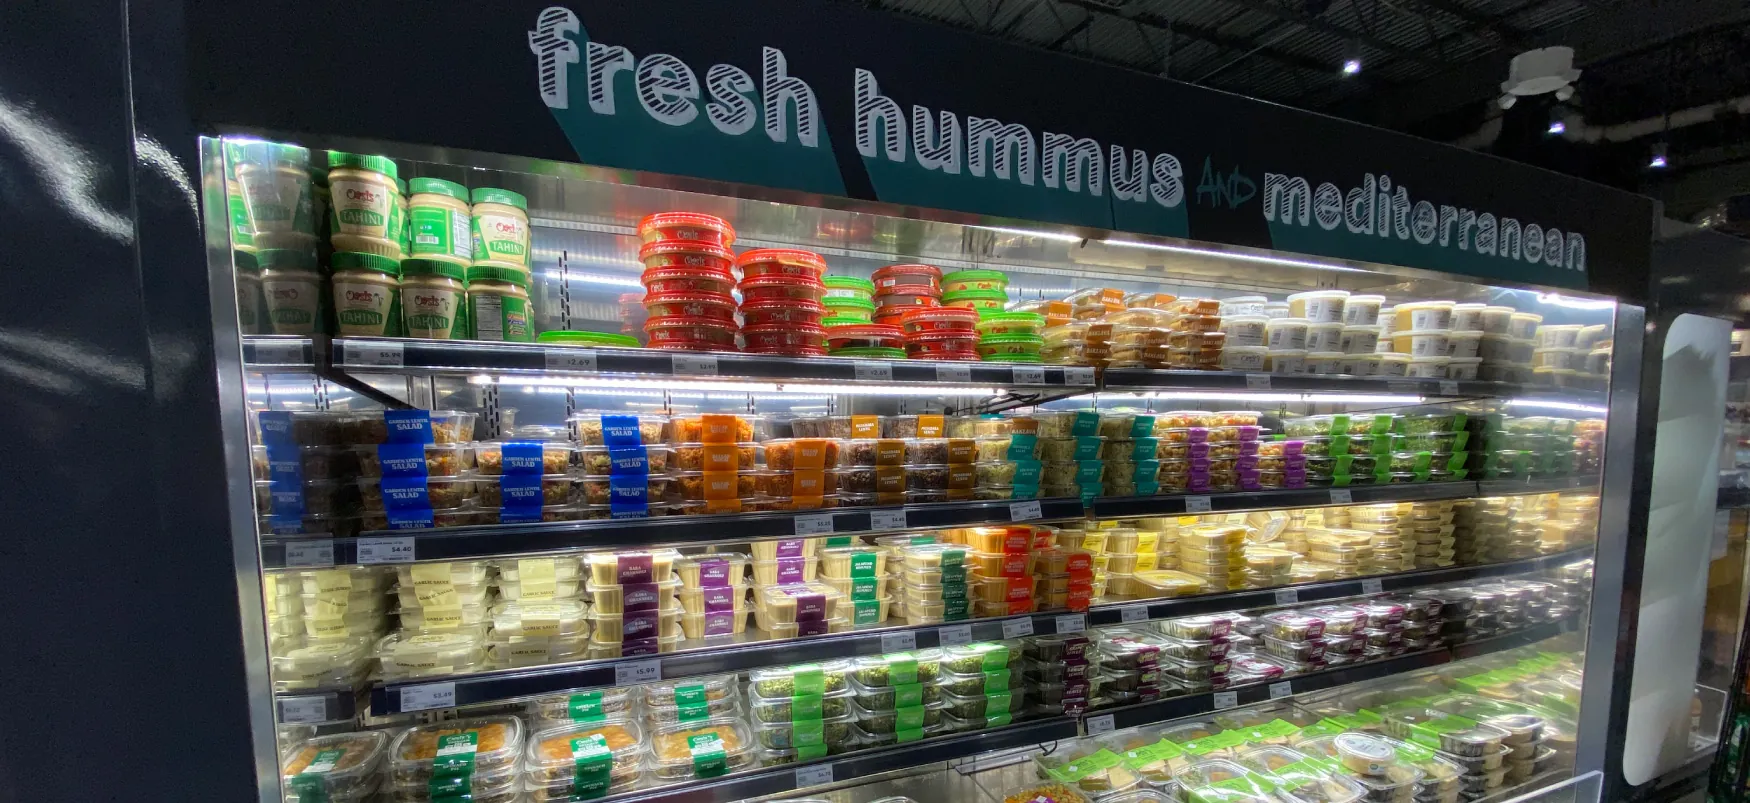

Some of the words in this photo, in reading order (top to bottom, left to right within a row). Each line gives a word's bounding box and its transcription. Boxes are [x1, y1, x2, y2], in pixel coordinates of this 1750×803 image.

[528, 7, 818, 147] fresh
[855, 68, 1184, 207] hummus
[1197, 155, 1257, 209] AND
[1263, 173, 1585, 271] mediterranean
[346, 188, 374, 203] Oasis
[342, 210, 382, 226] TAHINI
[492, 241, 524, 255] TAHINI
[345, 290, 373, 302] Oasis
[414, 295, 440, 307] Oasis
[342, 312, 380, 325] TAHINI
[410, 316, 448, 329] TAHINI
[567, 359, 590, 367] $2.69
